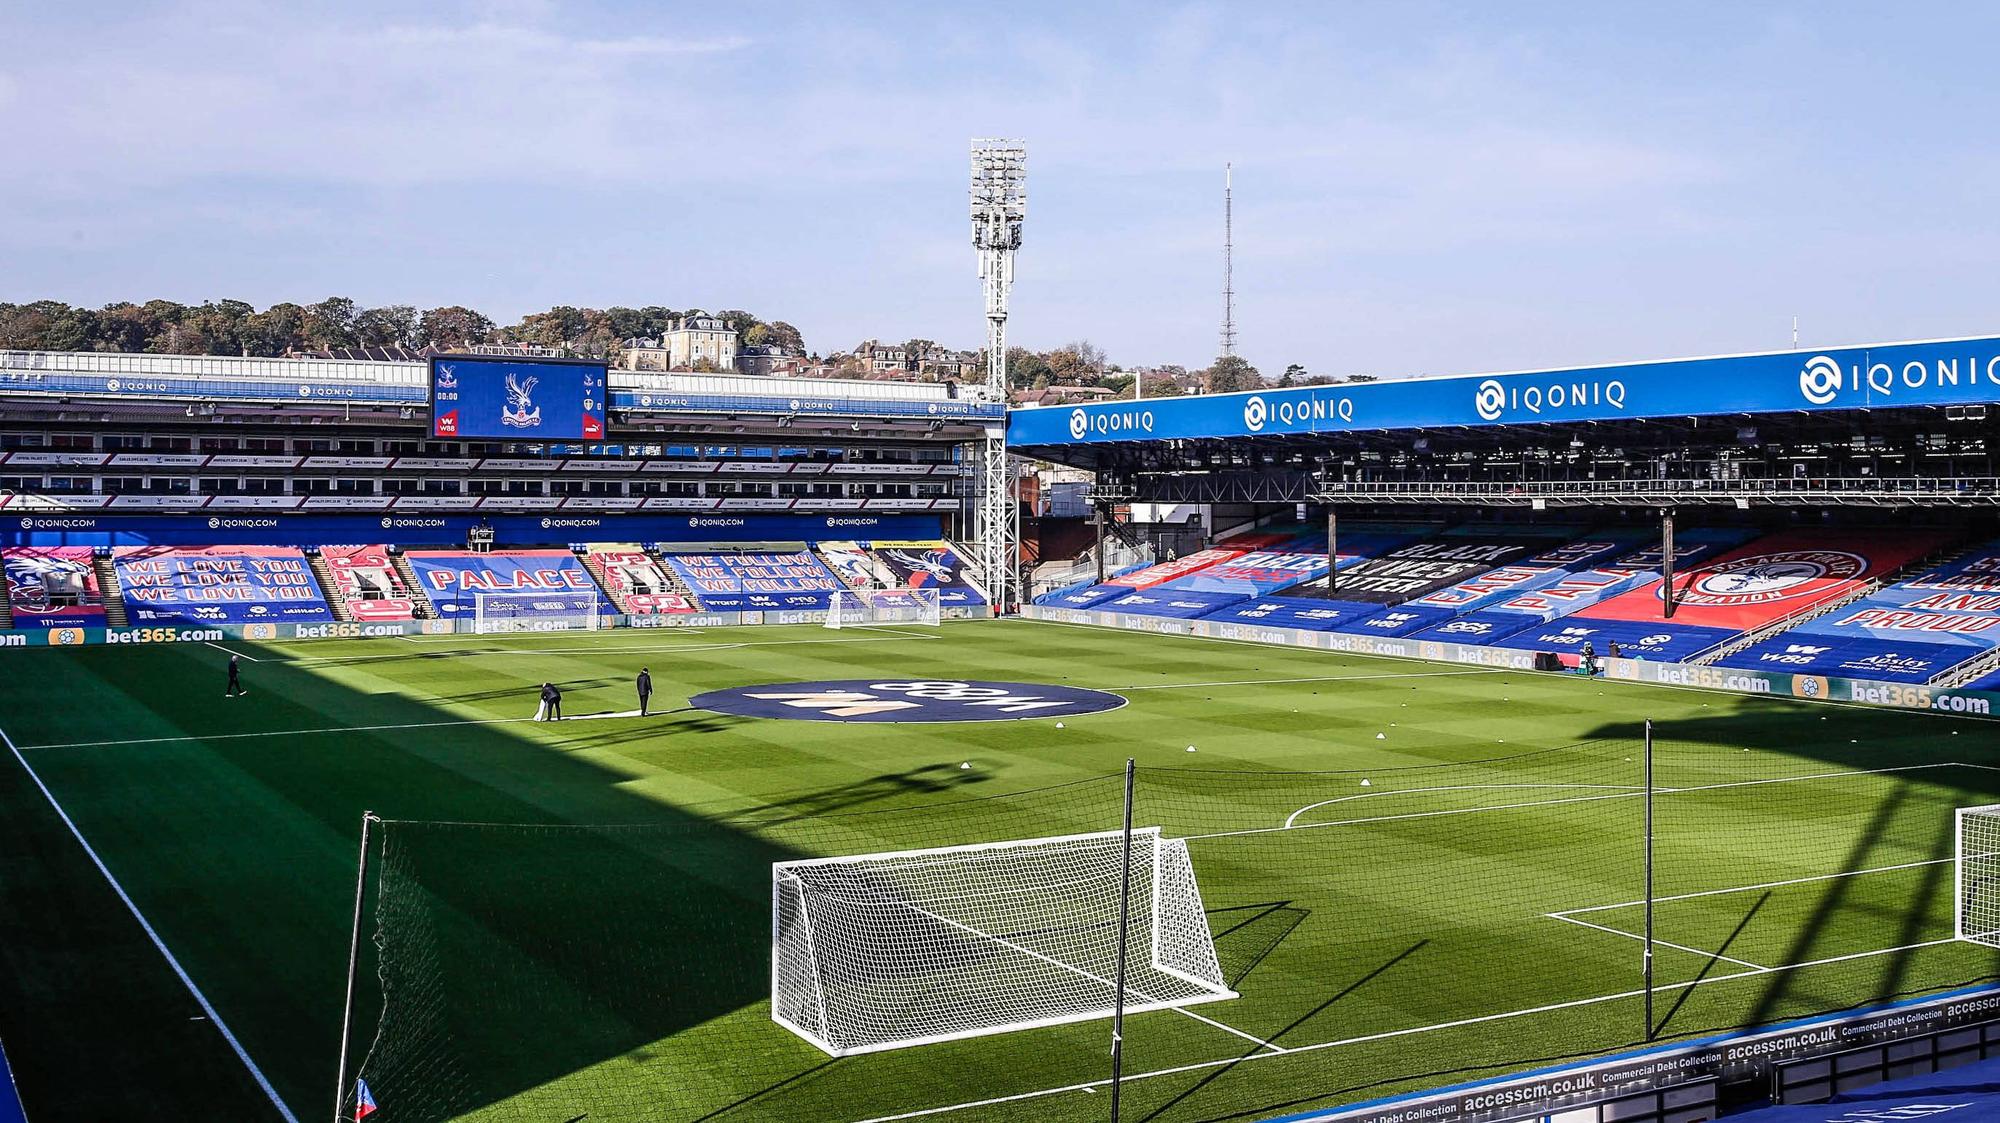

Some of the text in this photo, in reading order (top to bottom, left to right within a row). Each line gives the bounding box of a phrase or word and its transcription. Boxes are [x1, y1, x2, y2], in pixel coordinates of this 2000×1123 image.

[122, 383, 167, 391] IQONIQ
[313, 388, 353, 397] IQONIQ
[437, 392, 458, 400] 00:00
[1512, 380, 1625, 414] IQONIQ
[801, 402, 833, 410] IQONIQ
[1271, 398, 1353, 425] IQONIQ
[1090, 411, 1153, 435] IQONIQ
[35, 519, 95, 528] IQONIQ.COM
[221, 519, 277, 528] IQONIQ.COM
[394, 519, 445, 528] IQONIQ.COM
[552, 519, 600, 528] IQONIQ.COM
[699, 518, 744, 527] IQONIQ.COM
[835, 518, 878, 527] IQONIQ.COM
[676, 554, 813, 567] WE FOLLOW
[1388, 543, 1525, 562] BLACK
[126, 560, 302, 573] WE LOVE YOU
[686, 566, 825, 579] WE FOLLOW
[1340, 560, 1478, 579] LIVES
[129, 573, 309, 587] WE LOVE YOU
[428, 569, 597, 591] PALACE
[697, 578, 837, 592] WE FOLLOW
[1302, 576, 1433, 594] MATTER
[1901, 573, 2000, 591] LON
[131, 587, 315, 601] WE LOVE YOU
[631, 616, 722, 629] bet365.com
[1042, 608, 1092, 625] bet365.com
[1832, 609, 2000, 634] PROUD
[295, 622, 404, 638] bet365.com
[1125, 617, 1182, 634] bet365.com
[106, 627, 223, 645] bet365.com
[1220, 625, 1286, 645] bet365.com
[1537, 634, 1583, 644] W88
[1330, 635, 1405, 656] bet365.com
[1458, 646, 1532, 669] bet365.co
[1760, 652, 1816, 664] W88
[1860, 656, 1932, 668] Apsley
[1657, 665, 1770, 693] bet365.com
[1851, 681, 1990, 714] bet365.com
[1842, 1009, 1943, 1037] Commercial Debt Collection
[1728, 1026, 1837, 1061] accesscm.co.uk
[1602, 1051, 1722, 1084] Commercial Debt Collection
[1464, 1072, 1596, 1112] accesscm.co.uk
[1379, 1103, 1457, 1123] Debt Collection
